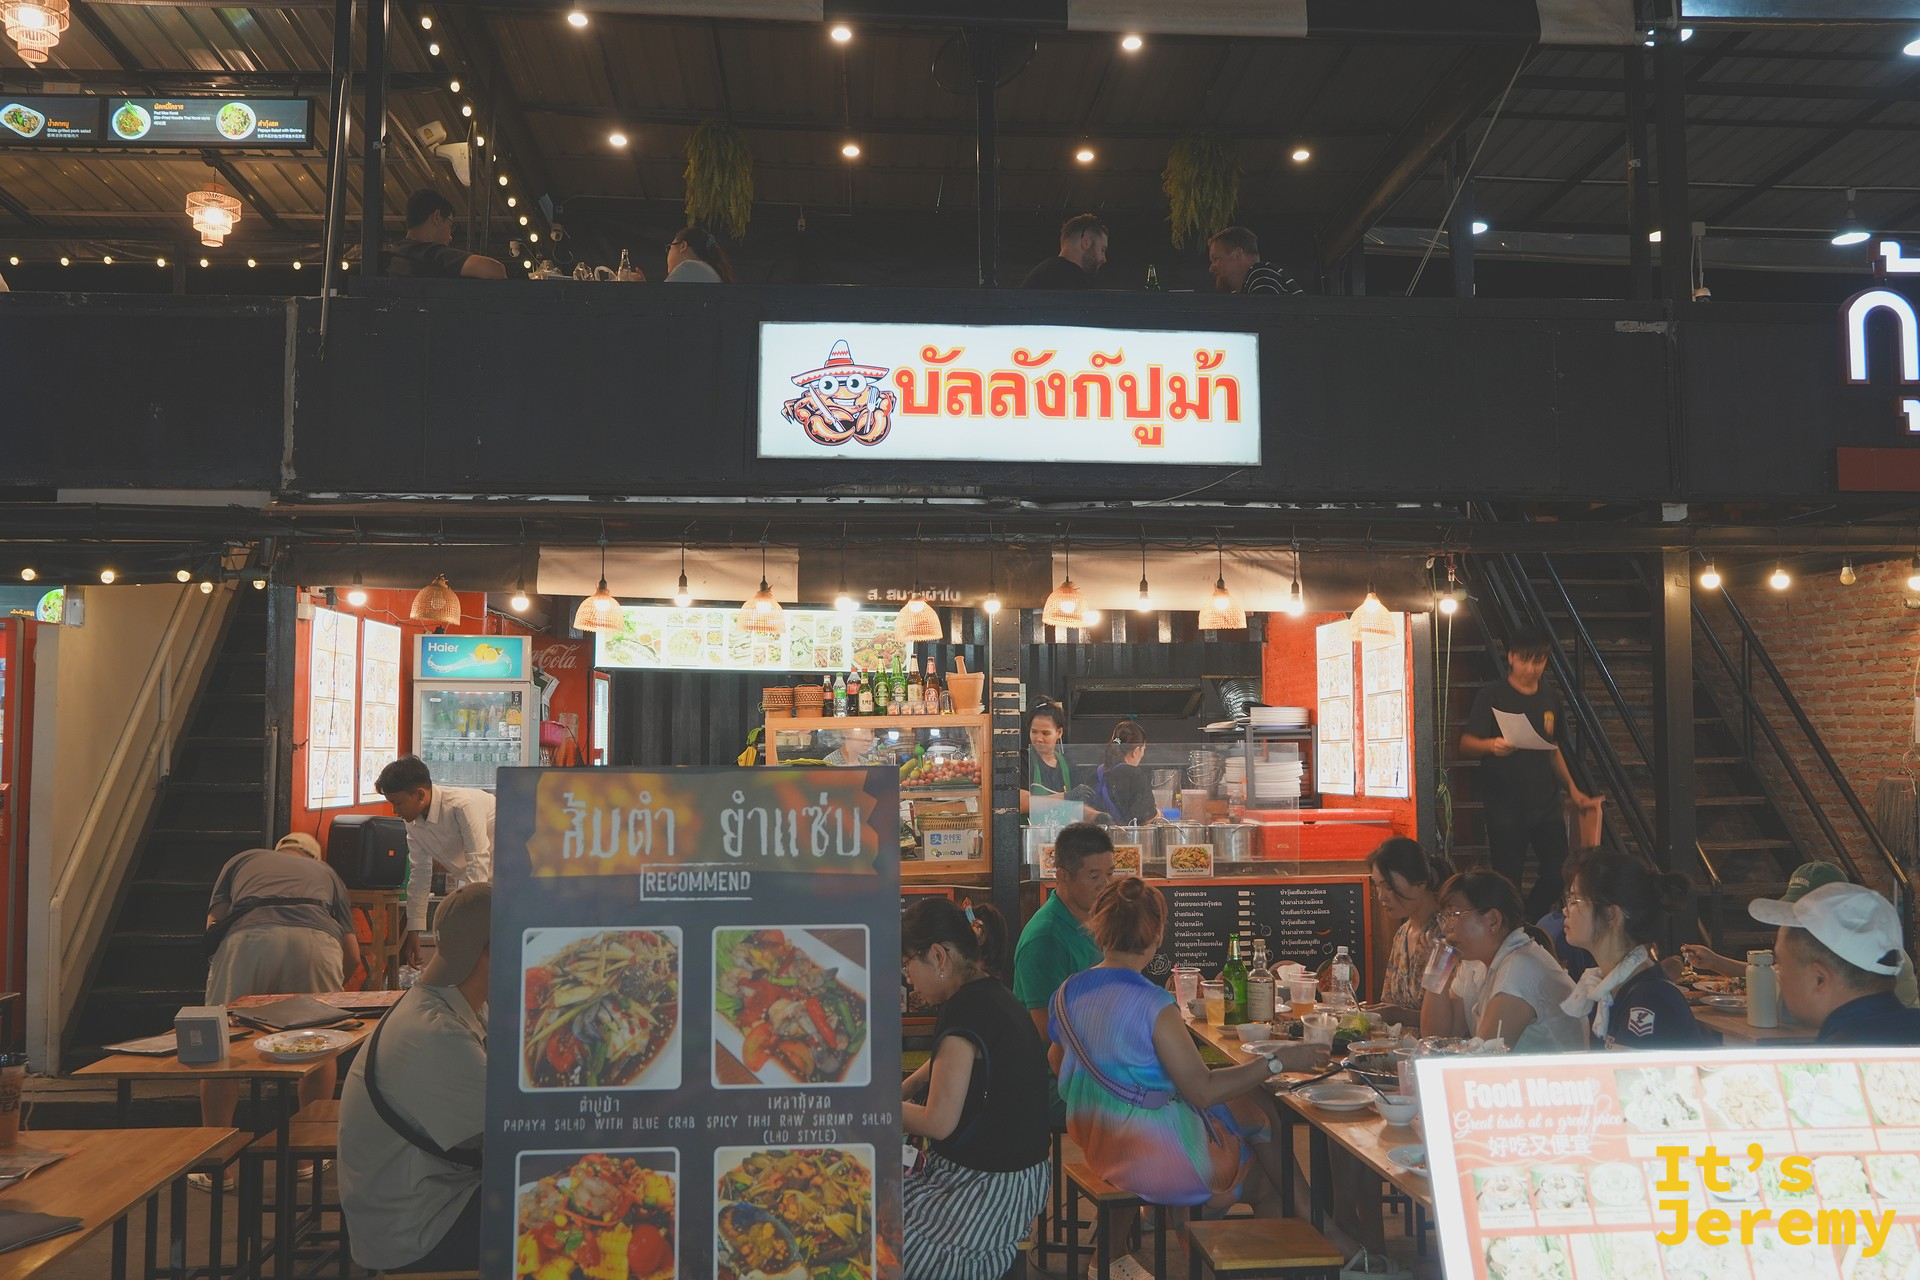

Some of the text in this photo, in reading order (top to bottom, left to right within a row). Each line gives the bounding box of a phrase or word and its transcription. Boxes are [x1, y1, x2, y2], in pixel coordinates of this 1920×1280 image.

[892, 345, 1242, 448] บัลลังก์ปูม้า
[428, 642, 459, 653] Haier
[645, 871, 752, 892] RECOMMEND
[1464, 1077, 1594, 1109] Food Menu
[503, 1115, 696, 1132] PAPAYA SALAD WITH BLUE CRAB
[706, 1112, 892, 1128] SPICY THAI RAW SHRIMP SALAD
[1453, 1110, 1493, 1138] Great
[1528, 1112, 1542, 1128] at
[1557, 1112, 1590, 1134] great
[797, 1128, 837, 1144] STYLE)
[1488, 1134, 1593, 1157] 好吃又便宜
